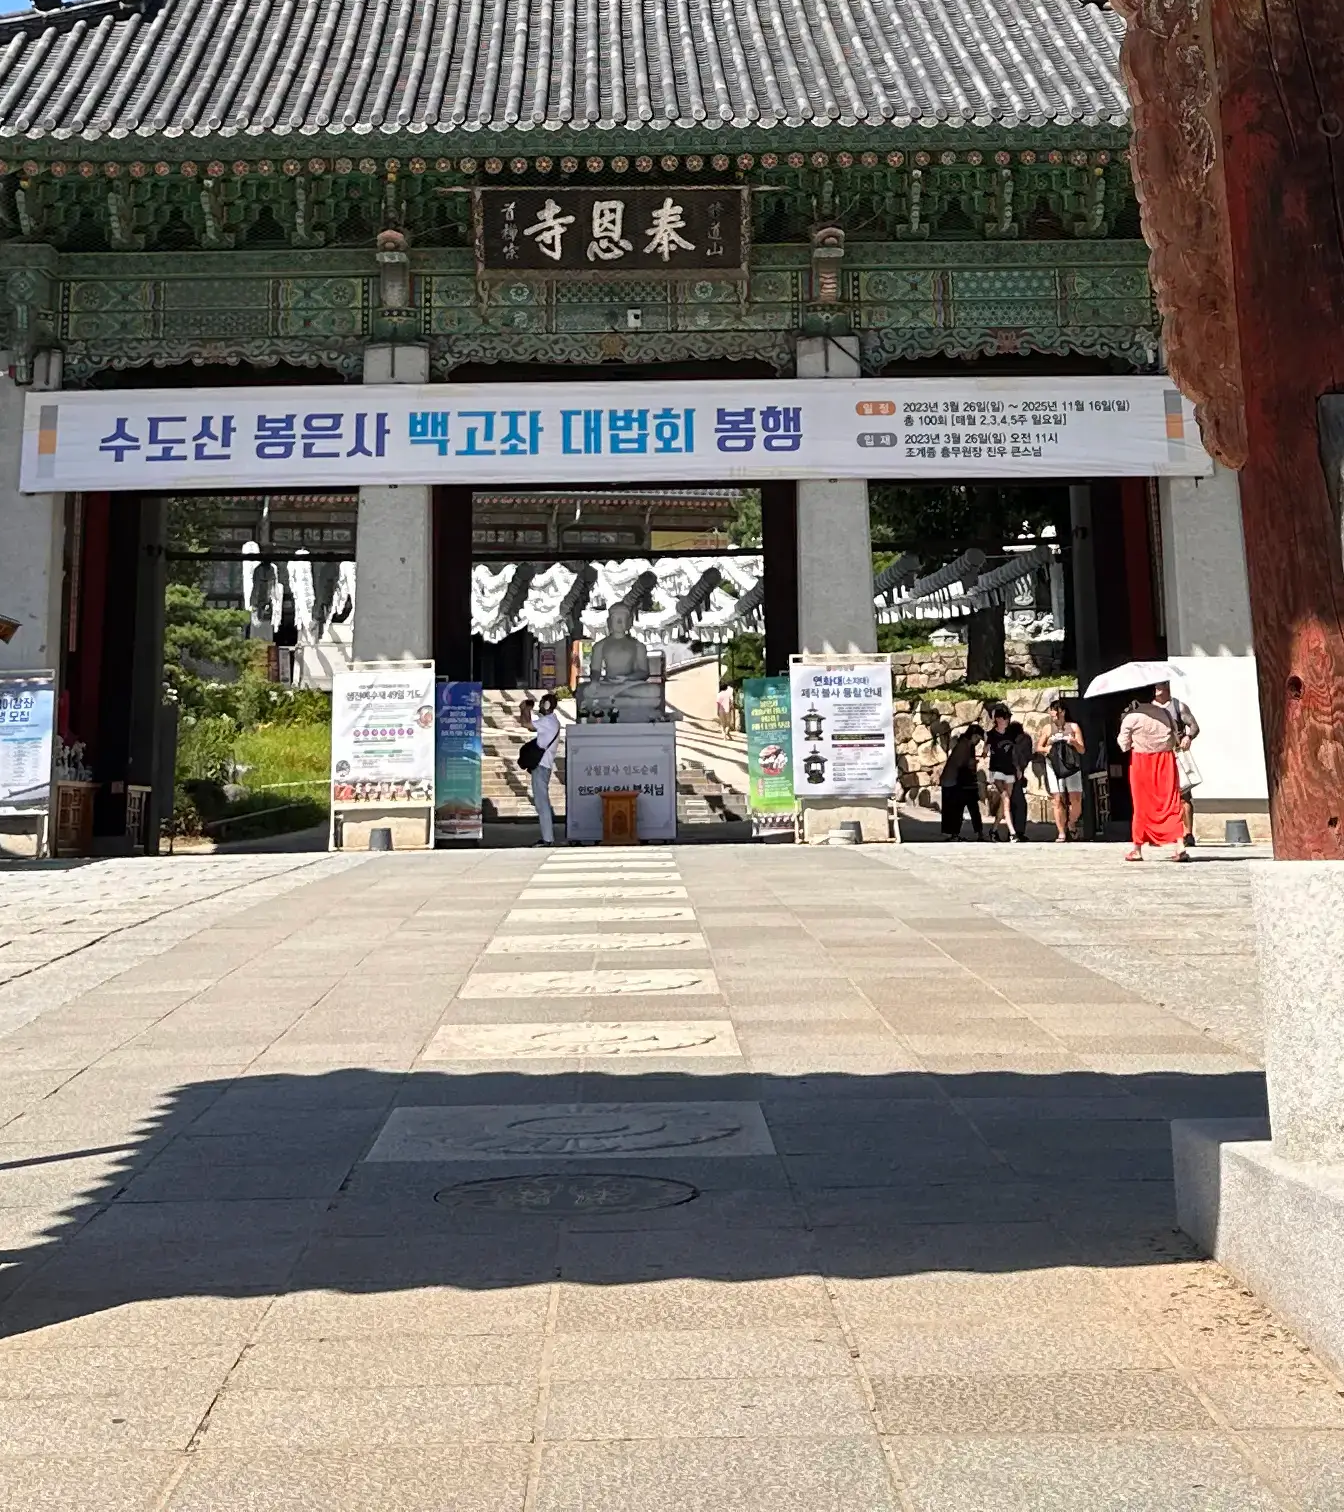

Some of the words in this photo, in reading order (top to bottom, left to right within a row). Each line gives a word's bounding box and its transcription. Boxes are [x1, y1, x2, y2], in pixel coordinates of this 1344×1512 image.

[523, 197, 696, 262] 奉恩寺
[903, 402, 939, 413] 2023년
[943, 401, 960, 413] 3월
[963, 400, 1005, 413] 26일(일)
[1021, 401, 1058, 412] 2025년
[1062, 400, 1085, 412] 11월
[1088, 399, 1131, 412] 16일(일)
[904, 415, 914, 426] 총
[919, 415, 948, 426] 100회
[98, 414, 237, 463] 수도산
[253, 412, 391, 460] 봉은사
[408, 410, 544, 457] 백고좌
[559, 407, 696, 455] 대법회
[714, 405, 804, 453] 봉행
[904, 433, 940, 444] 2023년
[944, 433, 961, 444] 3월
[964, 432, 1006, 445] 26일(일)
[1010, 433, 1031, 444] 오전
[1035, 432, 1058, 444] 11시
[905, 447, 936, 458] 조계종
[940, 447, 982, 458] 총무원장
[1011, 445, 1042, 457] 큰스님
[863, 687, 882, 697] 안내
[9, 710, 30, 722] 모집
